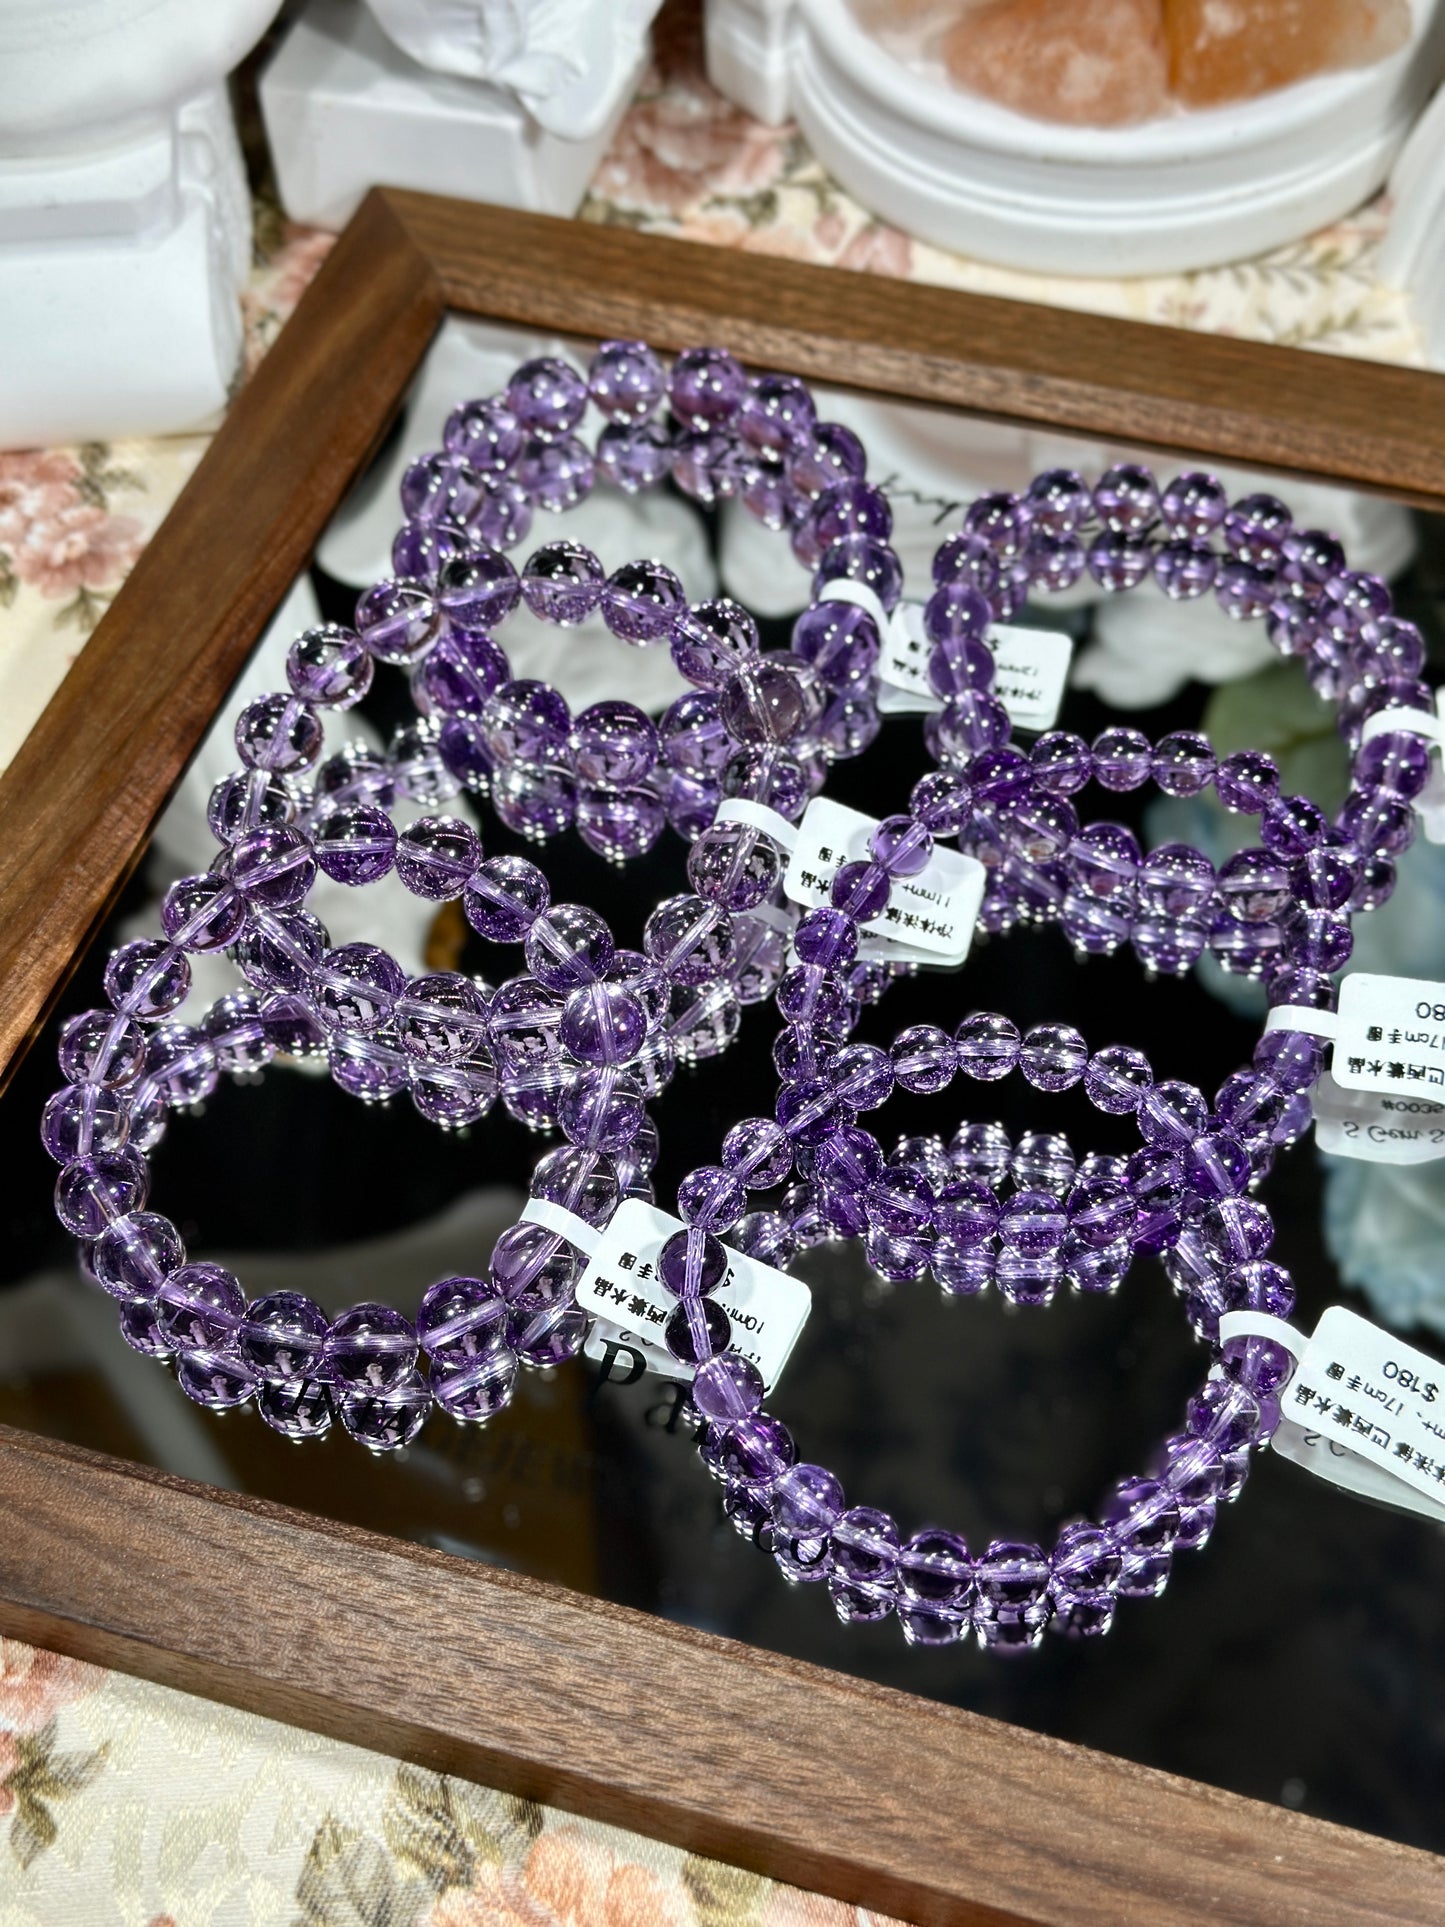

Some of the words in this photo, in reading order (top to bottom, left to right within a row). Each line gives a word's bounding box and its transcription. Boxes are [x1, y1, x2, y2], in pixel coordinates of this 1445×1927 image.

[800, 869, 830, 895] 水晶
[592, 1276, 668, 1327] 西紫水晶
[1381, 1359, 1440, 1404] $180
